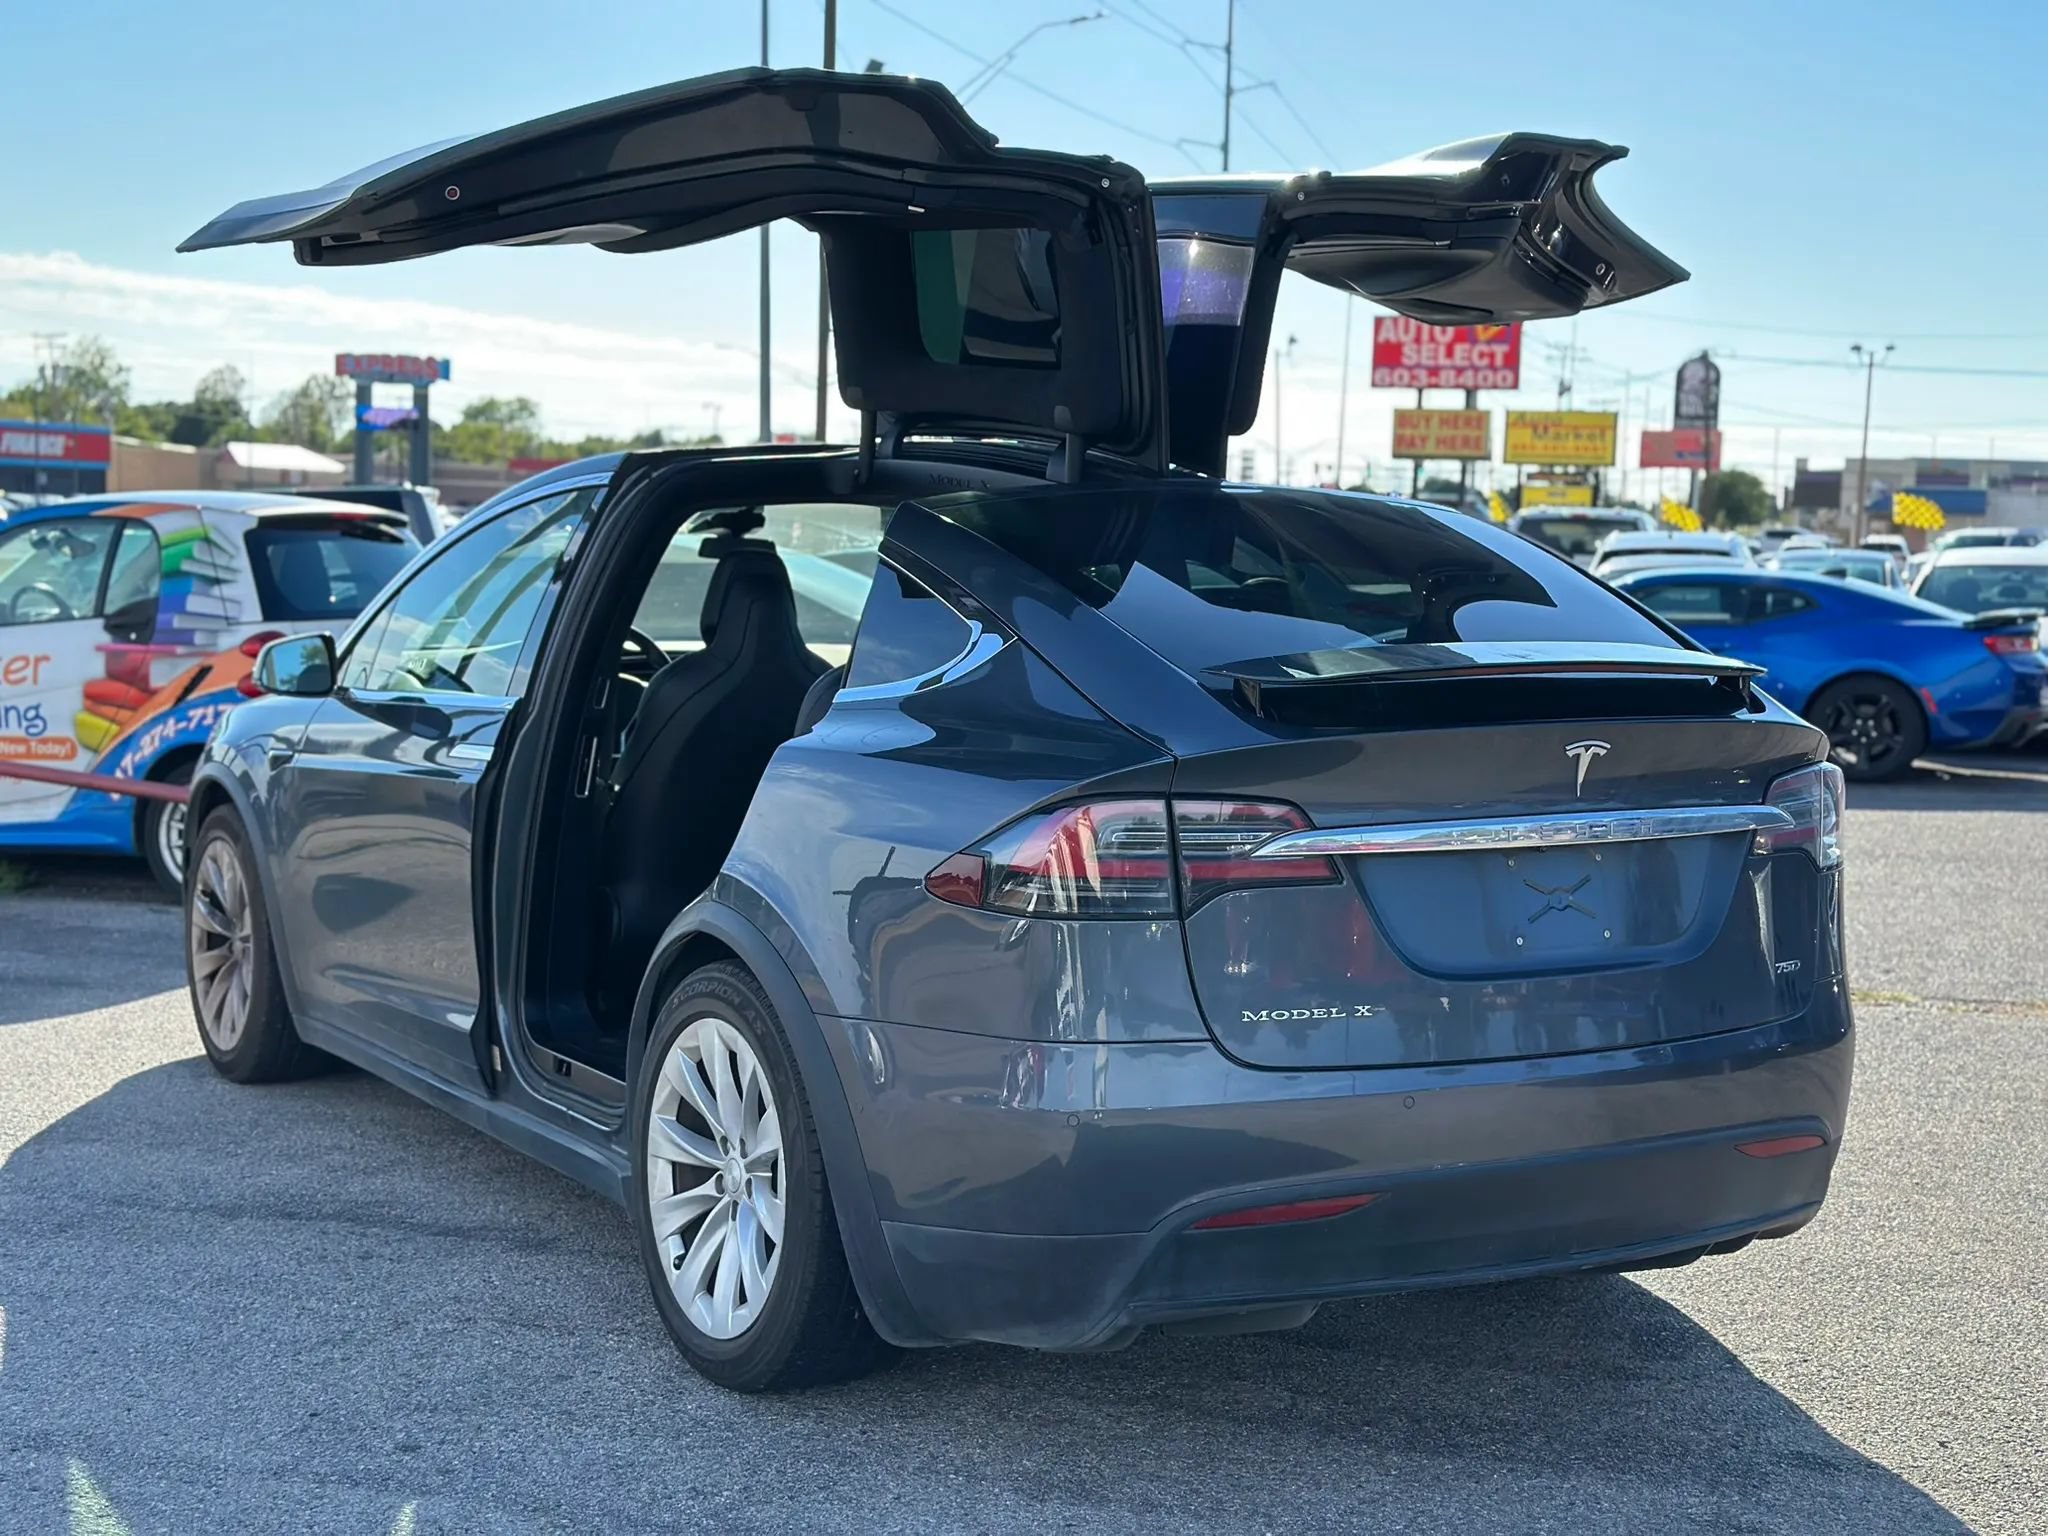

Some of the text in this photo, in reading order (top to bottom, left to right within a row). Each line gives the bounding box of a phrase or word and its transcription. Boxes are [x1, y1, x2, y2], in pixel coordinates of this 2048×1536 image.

[1377, 316, 1455, 344] AUTO
[1401, 342, 1510, 367] SELECT
[1373, 367, 1514, 388] 603-8400
[1397, 413, 1485, 432] BUY HERE
[1396, 432, 1483, 452] PAY HERE
[0, 655, 51, 687] er
[1775, 959, 1801, 974] 75D
[671, 981, 742, 1010] SCORPION
[1241, 1005, 1373, 1022] MODEL X
